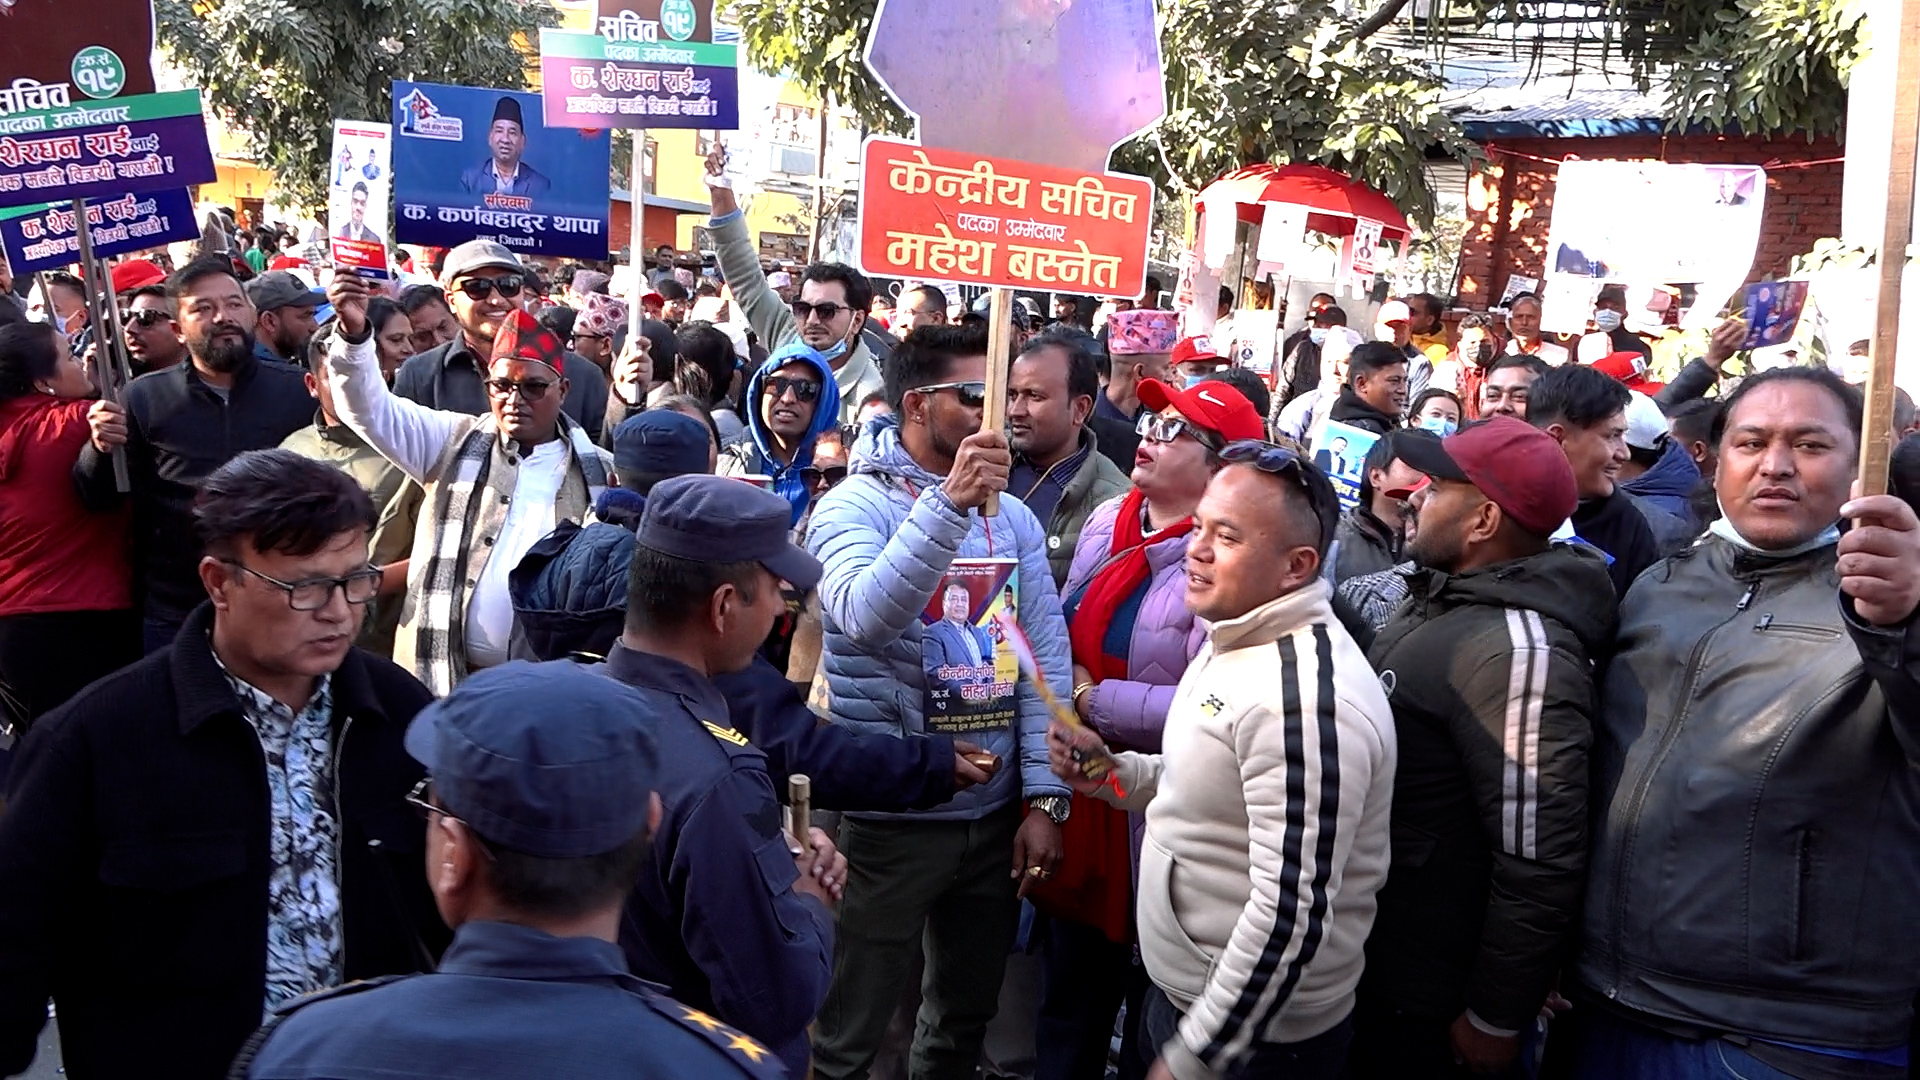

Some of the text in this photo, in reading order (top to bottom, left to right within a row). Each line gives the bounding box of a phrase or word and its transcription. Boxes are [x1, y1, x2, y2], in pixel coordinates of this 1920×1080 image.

[599, 9, 659, 43] सचिव
[663, 10, 691, 34] १९
[604, 45, 696, 64] पदका उम्मेदवार
[77, 67, 119, 93] १९
[570, 66, 598, 89] क.
[51, 105, 131, 128] उम्मेदवार
[67, 158, 115, 184] विजयी
[887, 150, 1137, 224] केन्द्रीय सचिव
[47, 206, 104, 235] शेरन
[403, 203, 601, 235] क. कर्णबहादुर थापा
[956, 212, 1067, 243] पदका उम्मेदवार
[886, 223, 1122, 289] महेश बस्नेत
[960, 679, 989, 700] महेश
